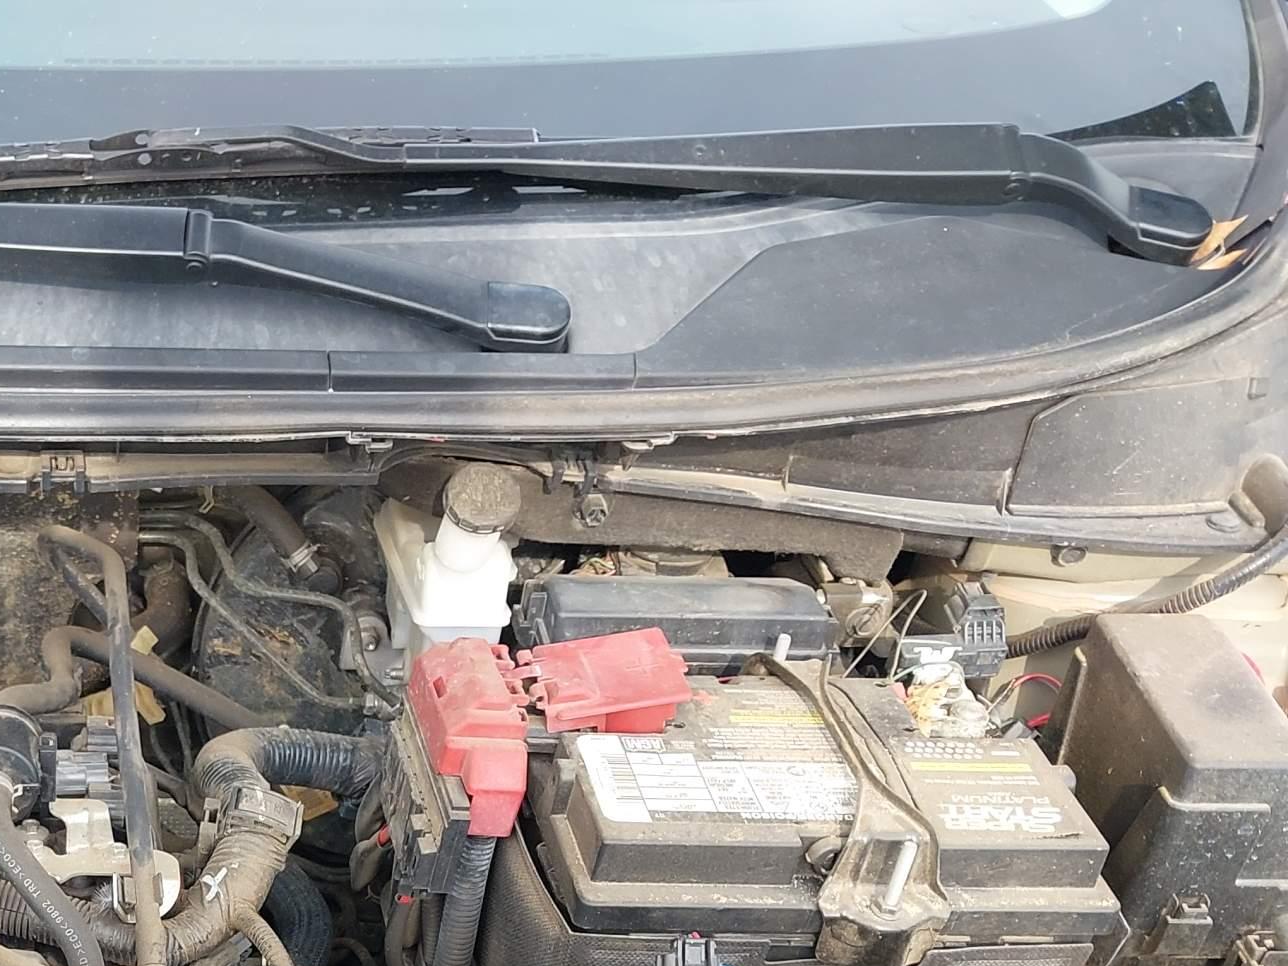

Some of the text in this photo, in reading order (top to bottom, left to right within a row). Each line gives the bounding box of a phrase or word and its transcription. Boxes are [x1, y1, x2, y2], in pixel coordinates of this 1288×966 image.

[951, 794, 1049, 804] PLATINUM
[937, 803, 1062, 823] START
[943, 820, 1056, 833] SUPER
